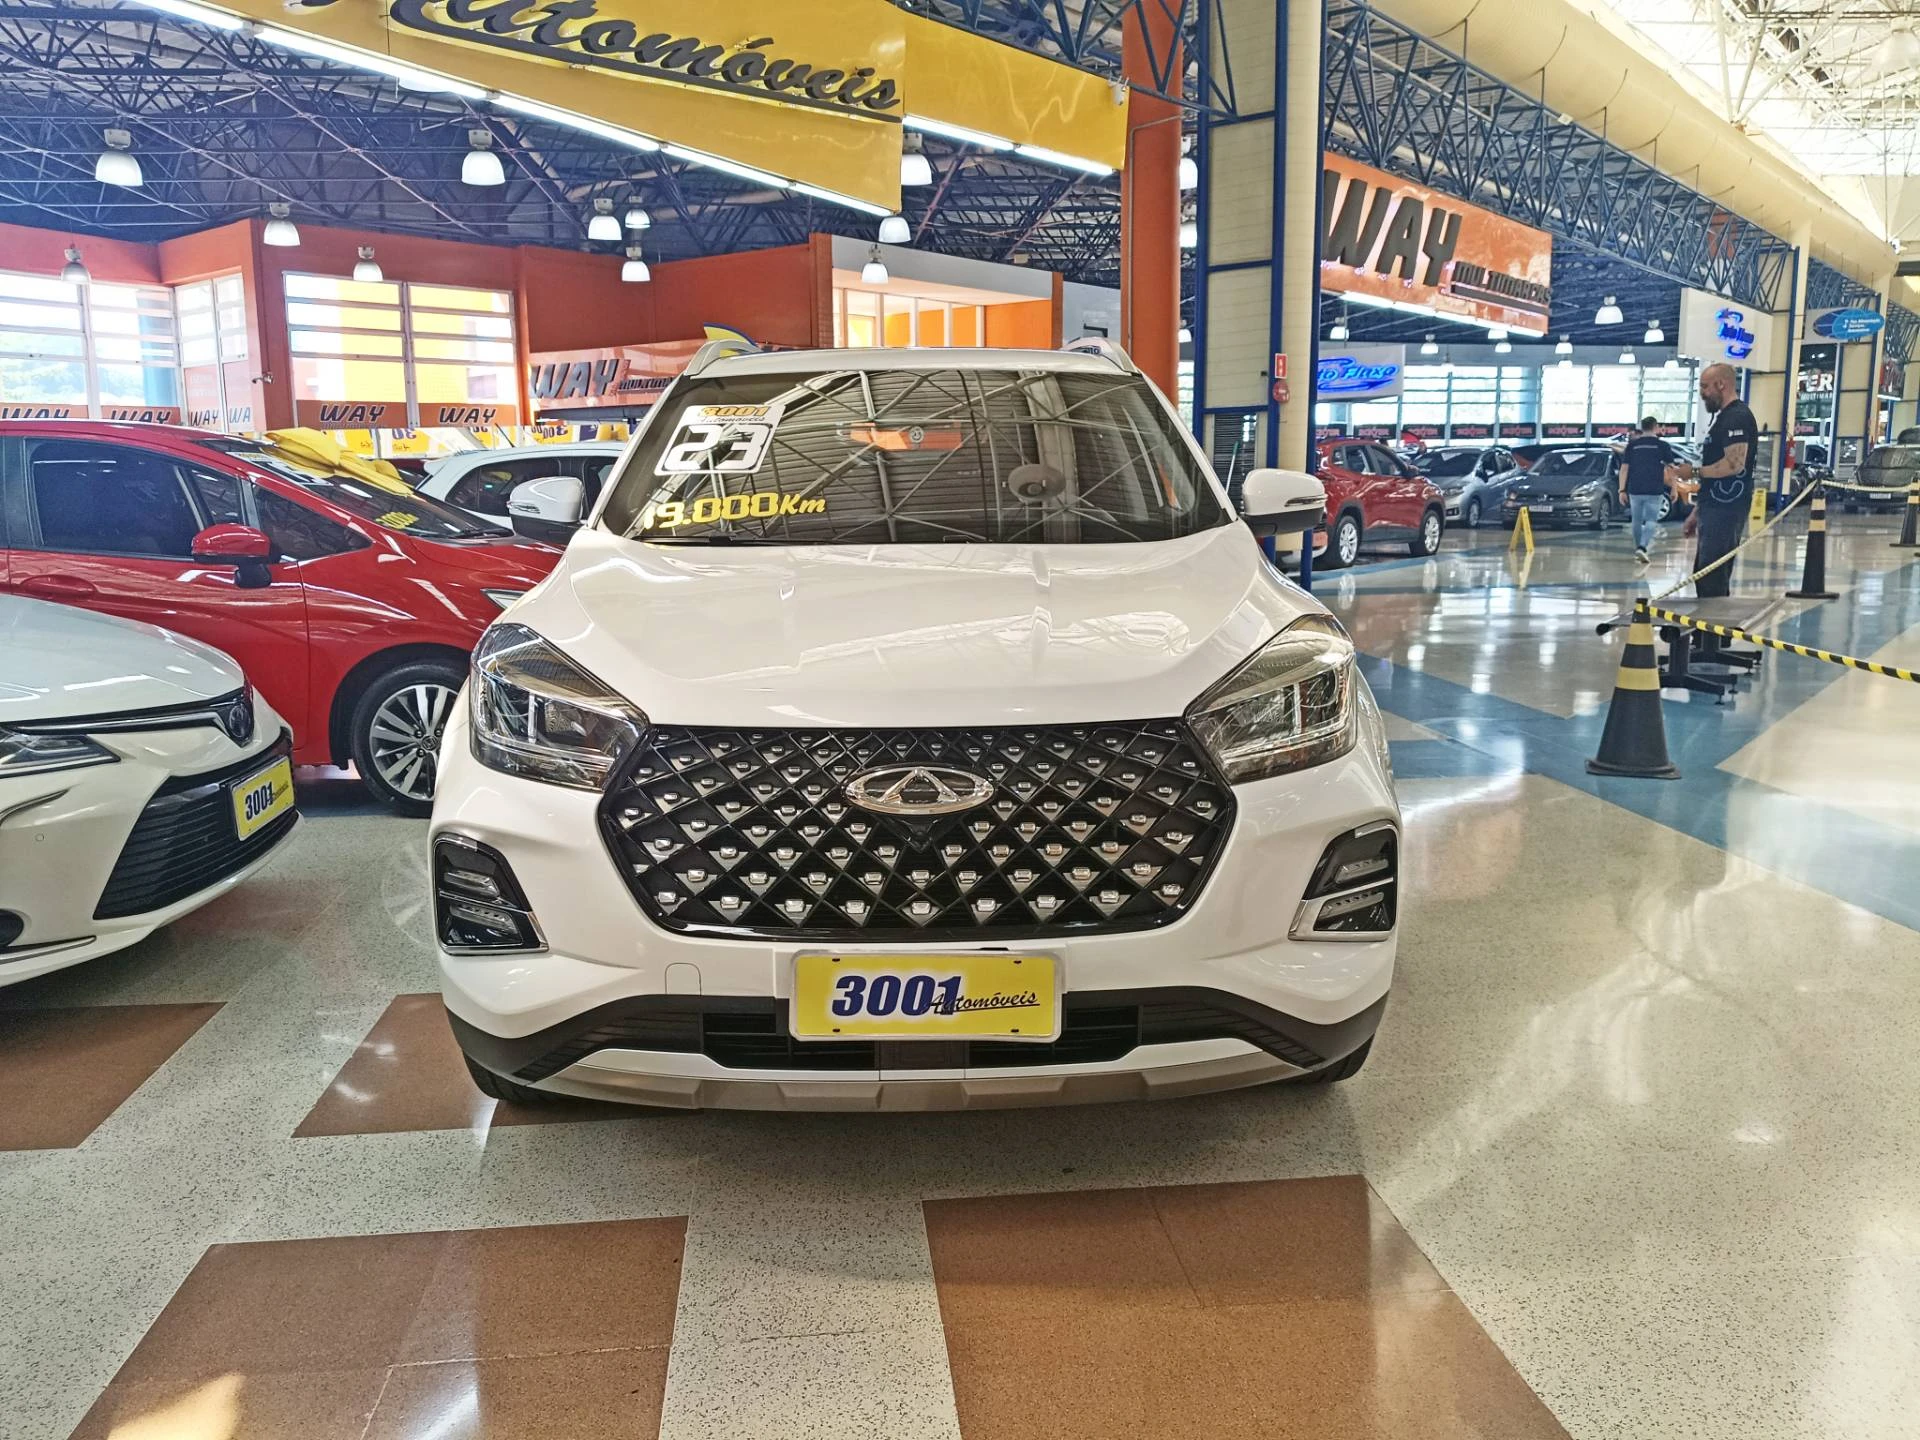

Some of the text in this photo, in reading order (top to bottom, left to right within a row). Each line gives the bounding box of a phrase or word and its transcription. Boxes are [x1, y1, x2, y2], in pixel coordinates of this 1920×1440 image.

[300, 0, 901, 110] utomóveis
[1323, 169, 1463, 287] WAY
[531, 358, 621, 398] WAY
[1341, 365, 1398, 380] Fluxo
[190, 409, 220, 426] WAY
[229, 406, 251, 424] WA
[319, 404, 386, 423] WAY
[439, 406, 497, 424] WAY
[702, 406, 771, 416] 3001
[664, 423, 771, 470] 23
[245, 781, 274, 821] 3001
[831, 975, 1041, 1017] 3001 Automóveis
